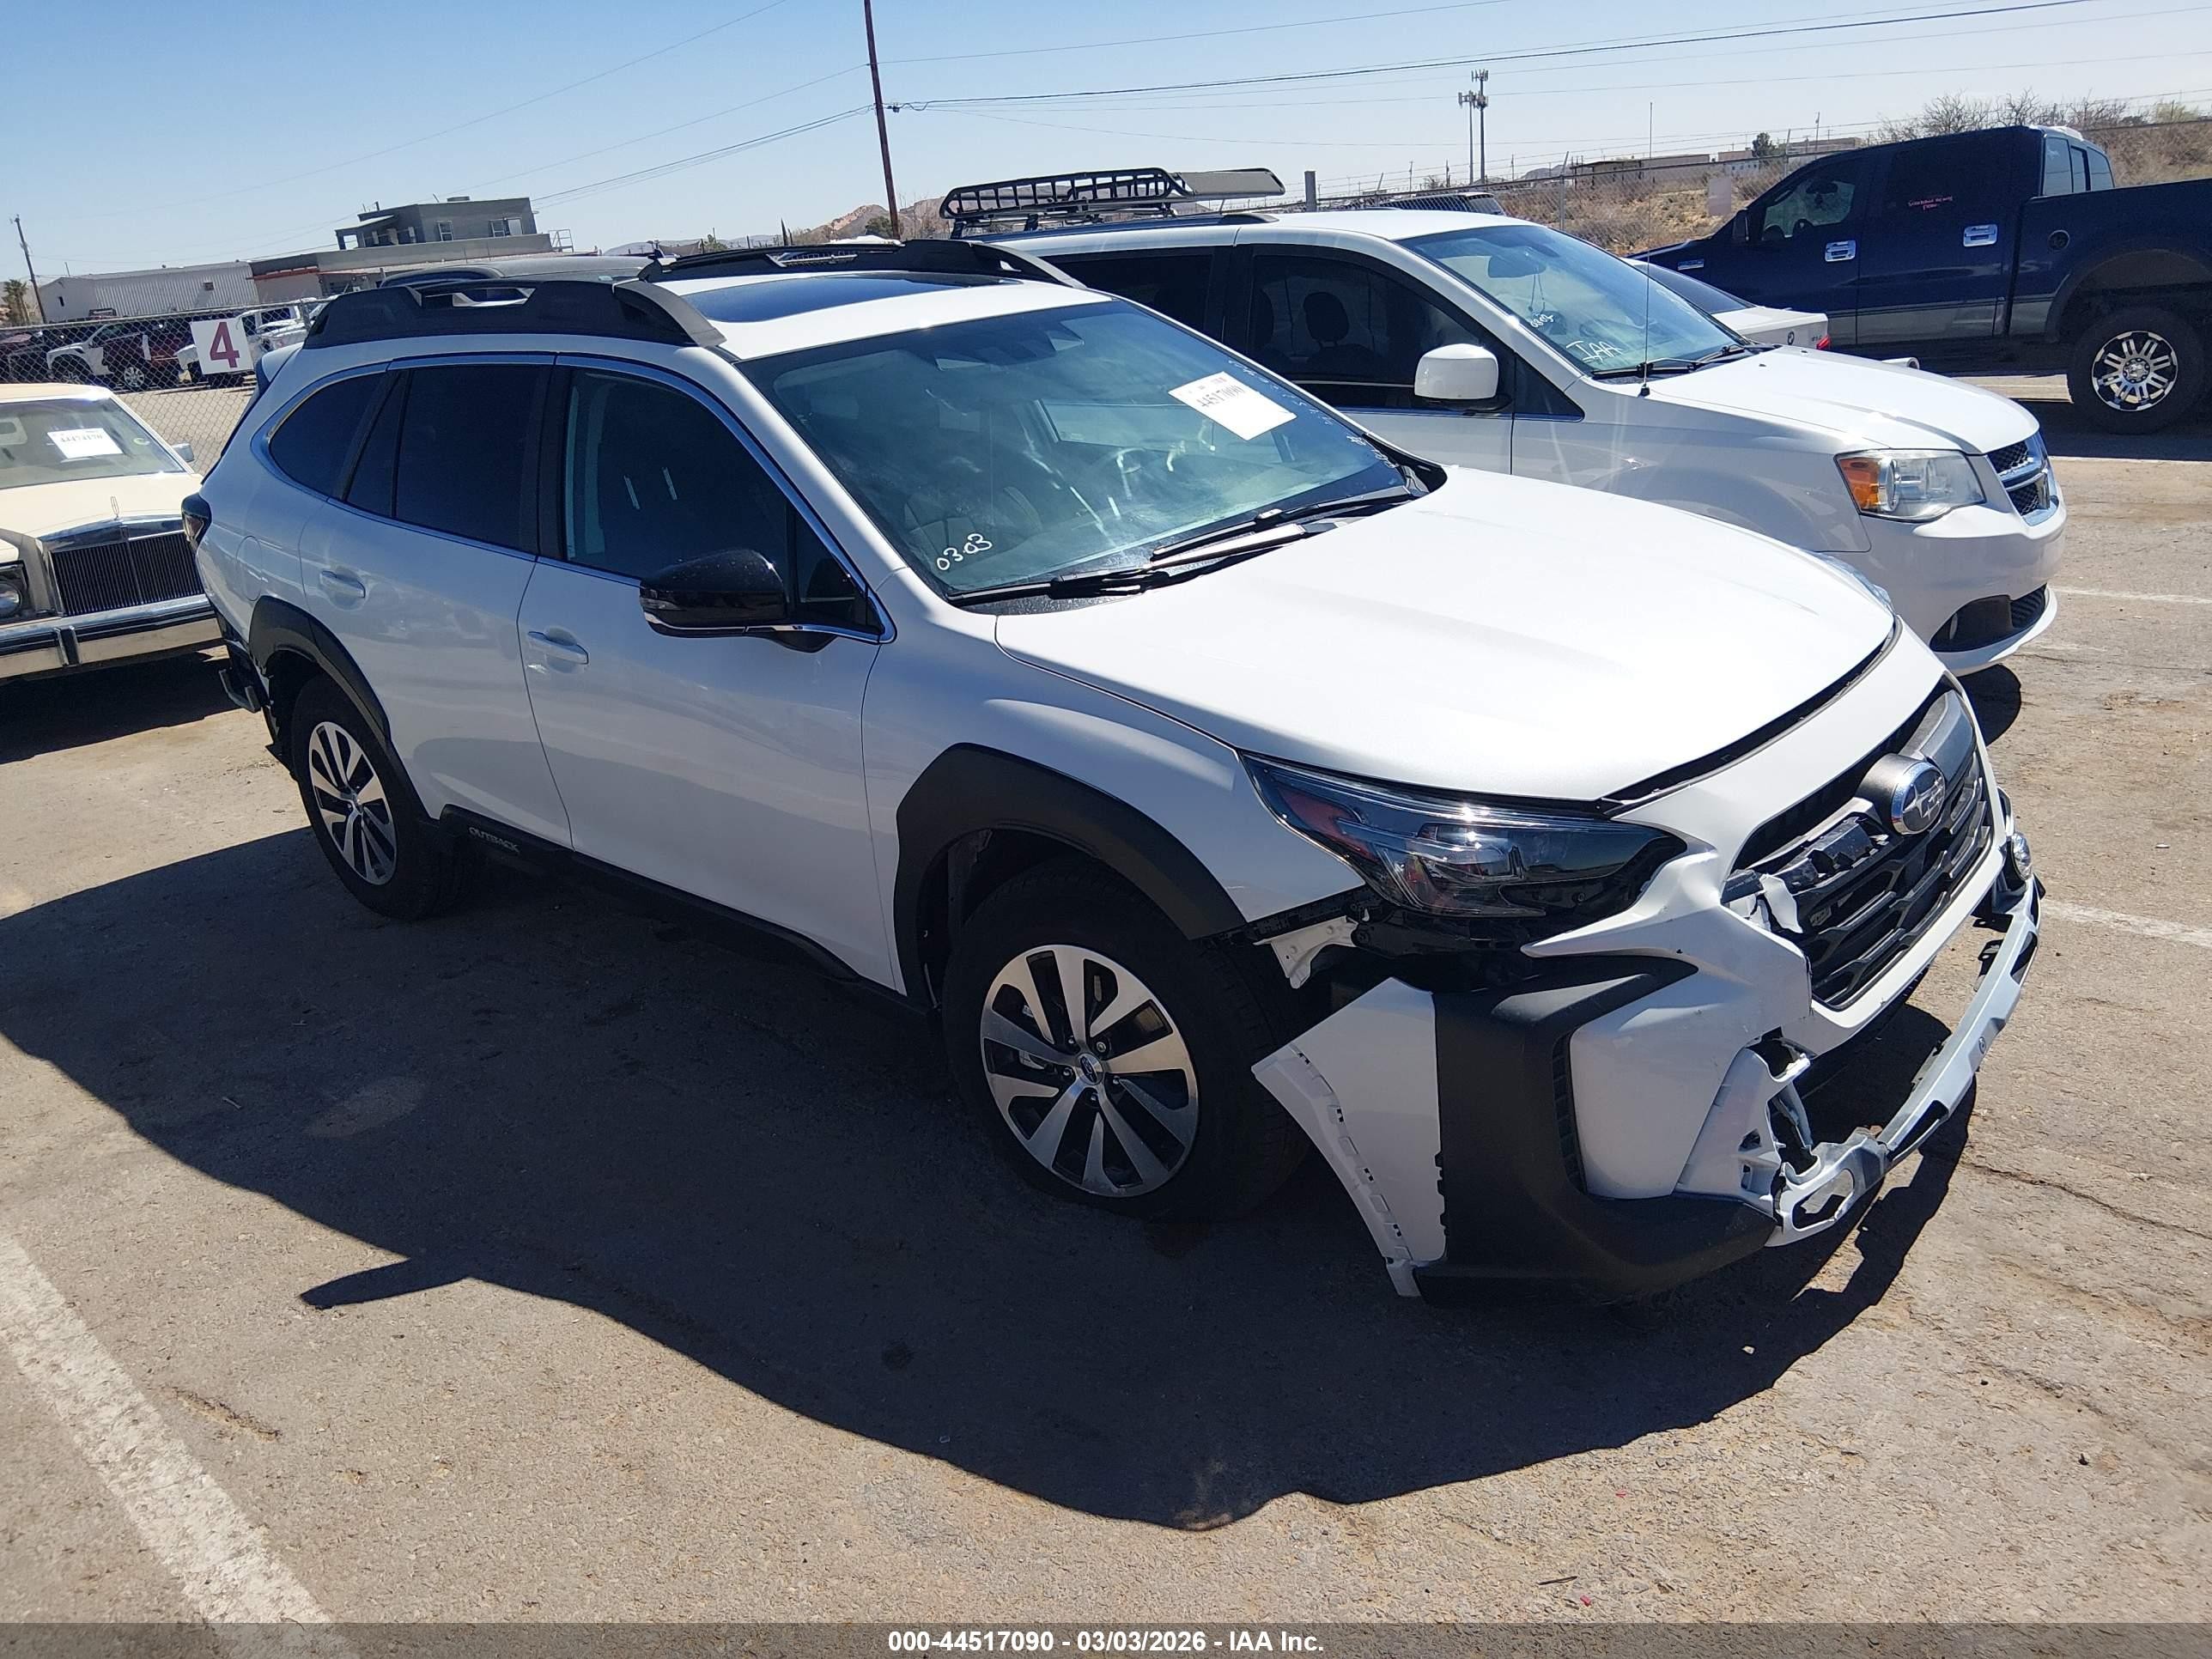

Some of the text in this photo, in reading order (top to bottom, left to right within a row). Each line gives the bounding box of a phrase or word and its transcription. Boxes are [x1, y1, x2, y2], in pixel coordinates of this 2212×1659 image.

[210, 321, 240, 368] 4
[1565, 340, 1624, 365] IAA
[468, 826, 520, 854] OUTBACK
